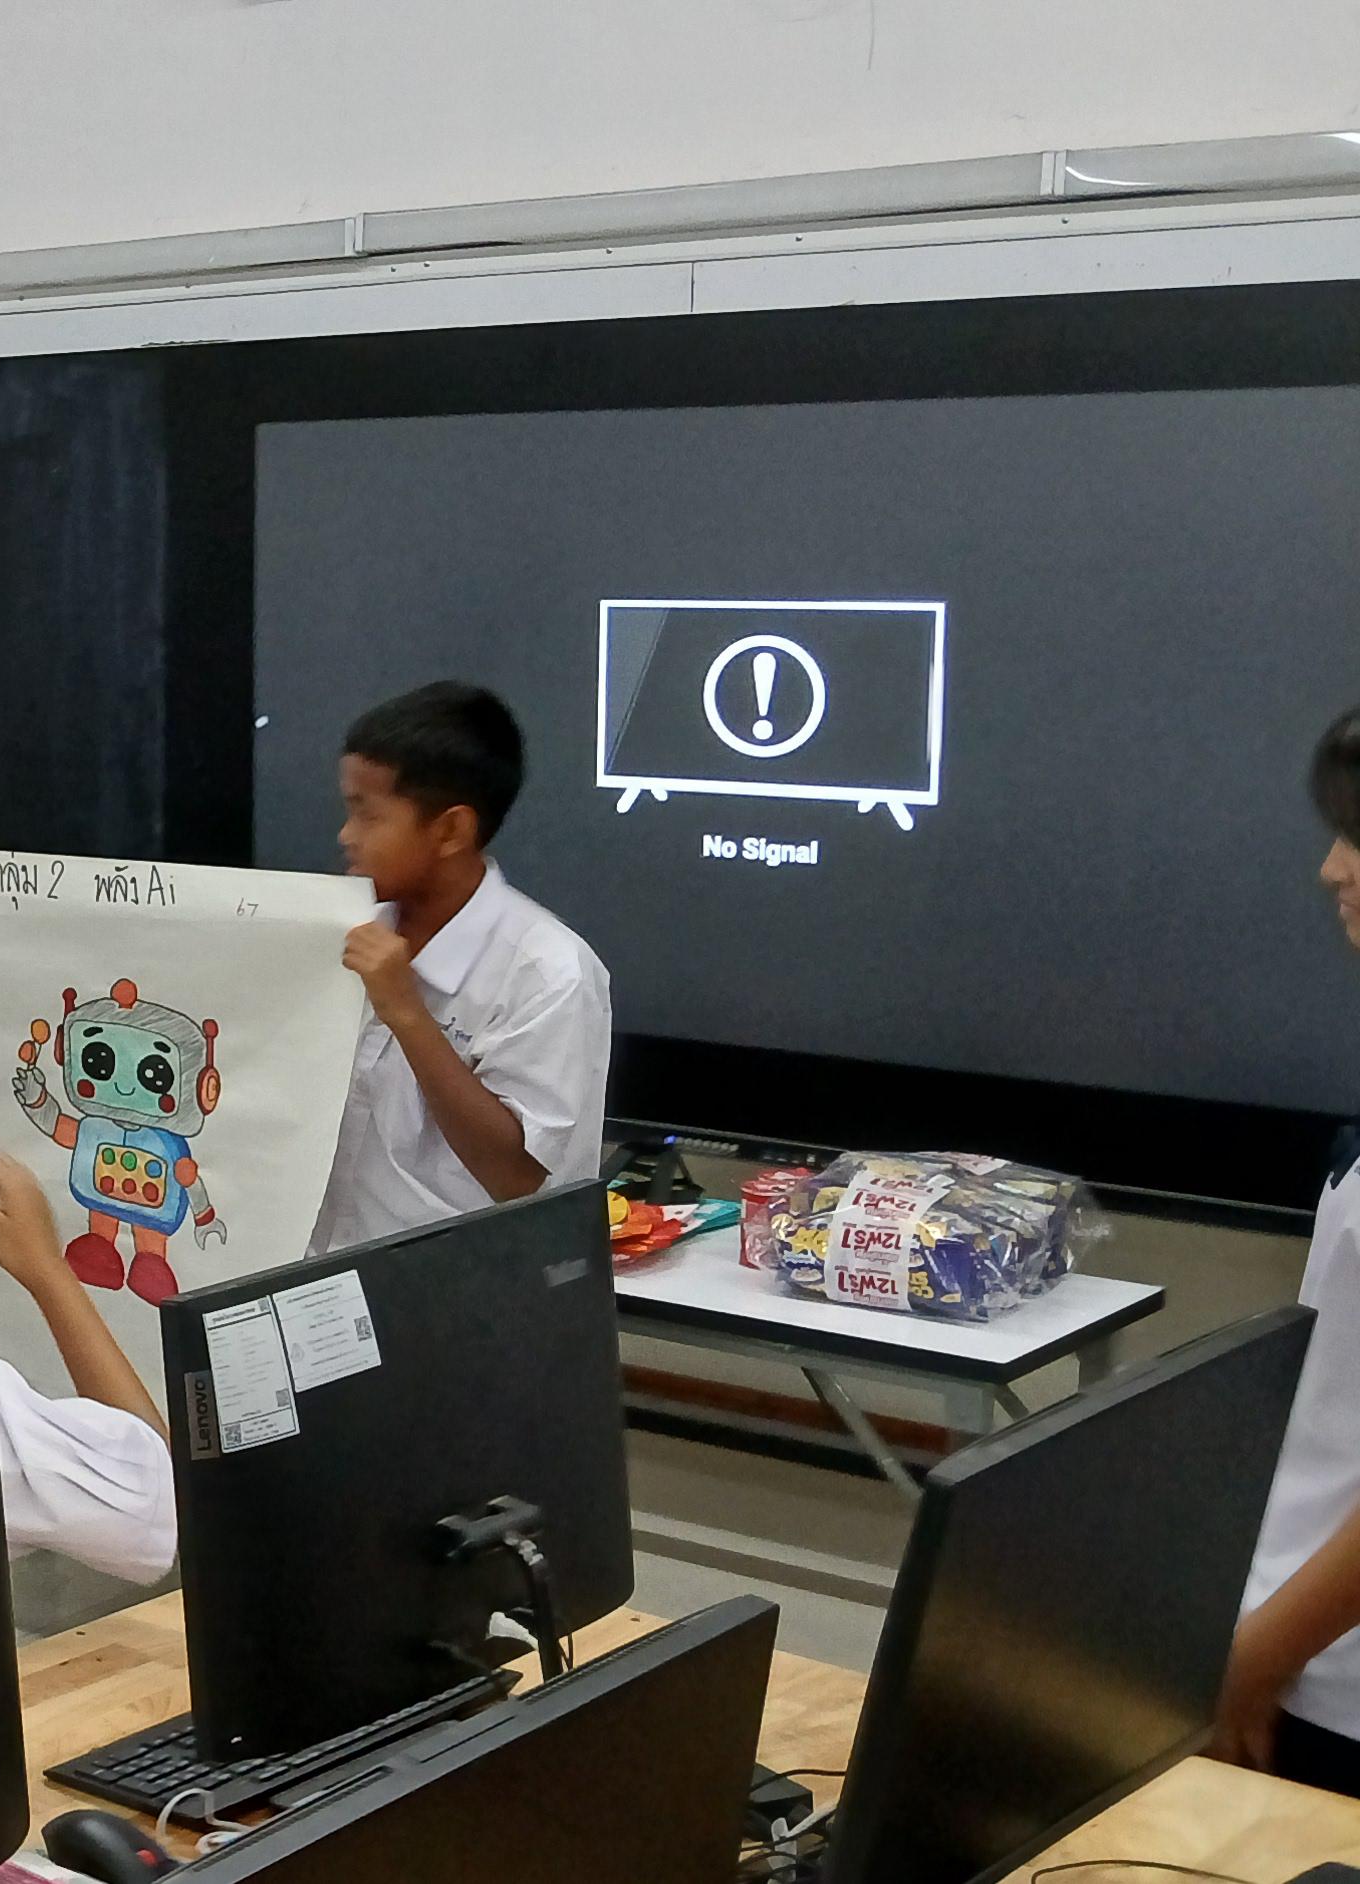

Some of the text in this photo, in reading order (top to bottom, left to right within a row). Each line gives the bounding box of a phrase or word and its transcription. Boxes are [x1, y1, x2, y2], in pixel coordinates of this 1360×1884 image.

[702, 834, 819, 867] No Signal
[47, 860, 65, 899] 2
[94, 865, 139, 905] พลัง
[147, 865, 176, 906] Ai
[194, 1378, 212, 1451] Lenovo
